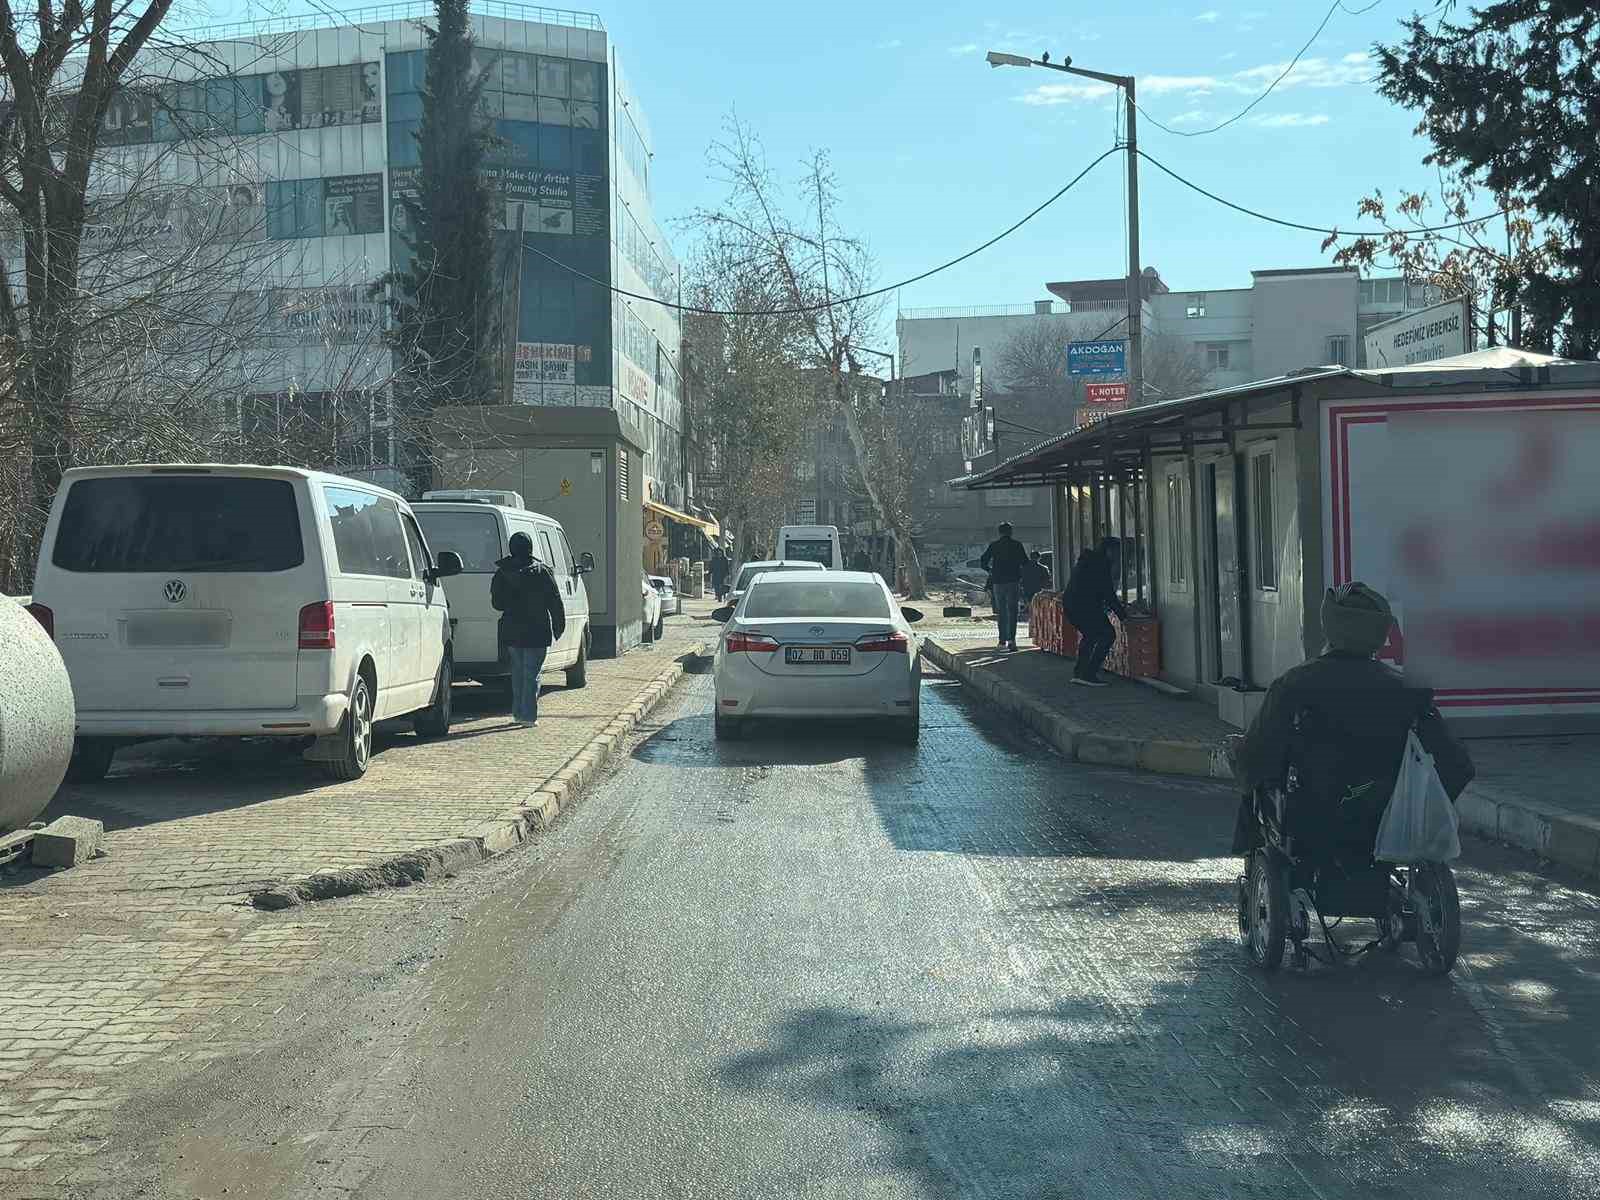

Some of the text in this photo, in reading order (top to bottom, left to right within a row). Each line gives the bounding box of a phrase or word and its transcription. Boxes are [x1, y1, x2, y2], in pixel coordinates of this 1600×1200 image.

[1099, 387, 1126, 396] NOTER
[792, 649, 803, 660] 02
[831, 649, 847, 660] 059
